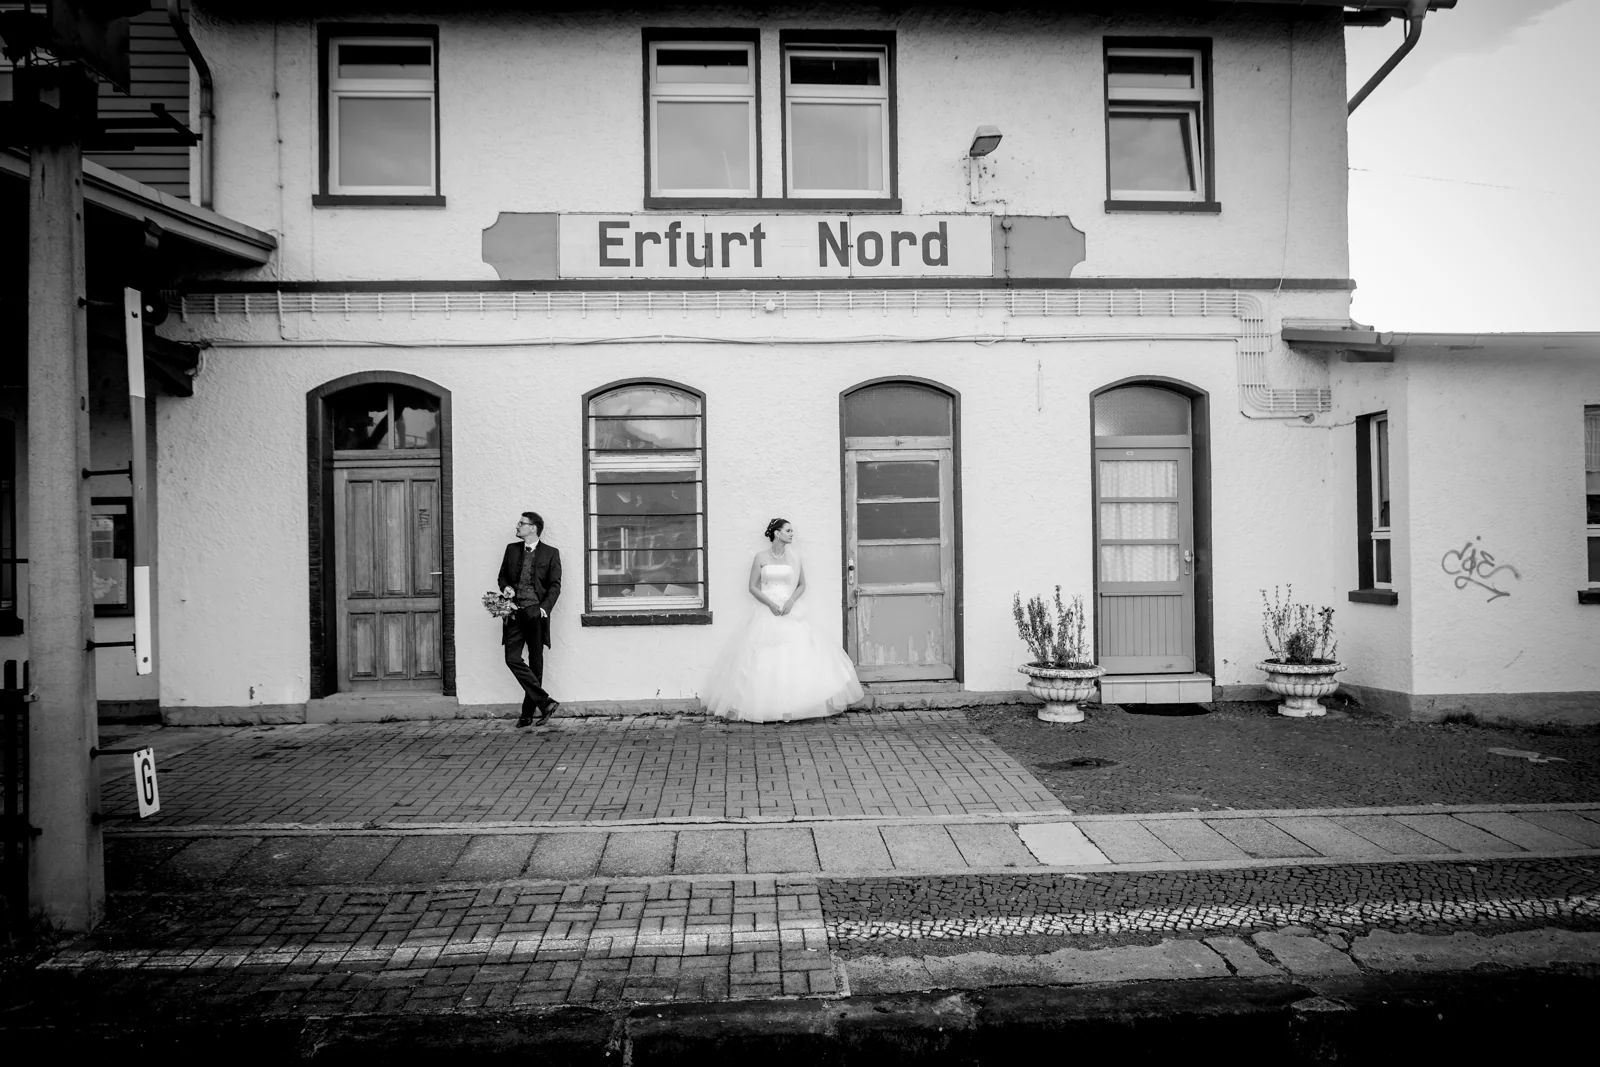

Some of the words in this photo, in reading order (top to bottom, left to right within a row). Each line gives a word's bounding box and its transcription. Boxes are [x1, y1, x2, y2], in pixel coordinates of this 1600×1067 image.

[598, 220, 767, 268] Erfurt
[818, 221, 949, 268] Nord
[141, 757, 155, 806] G
